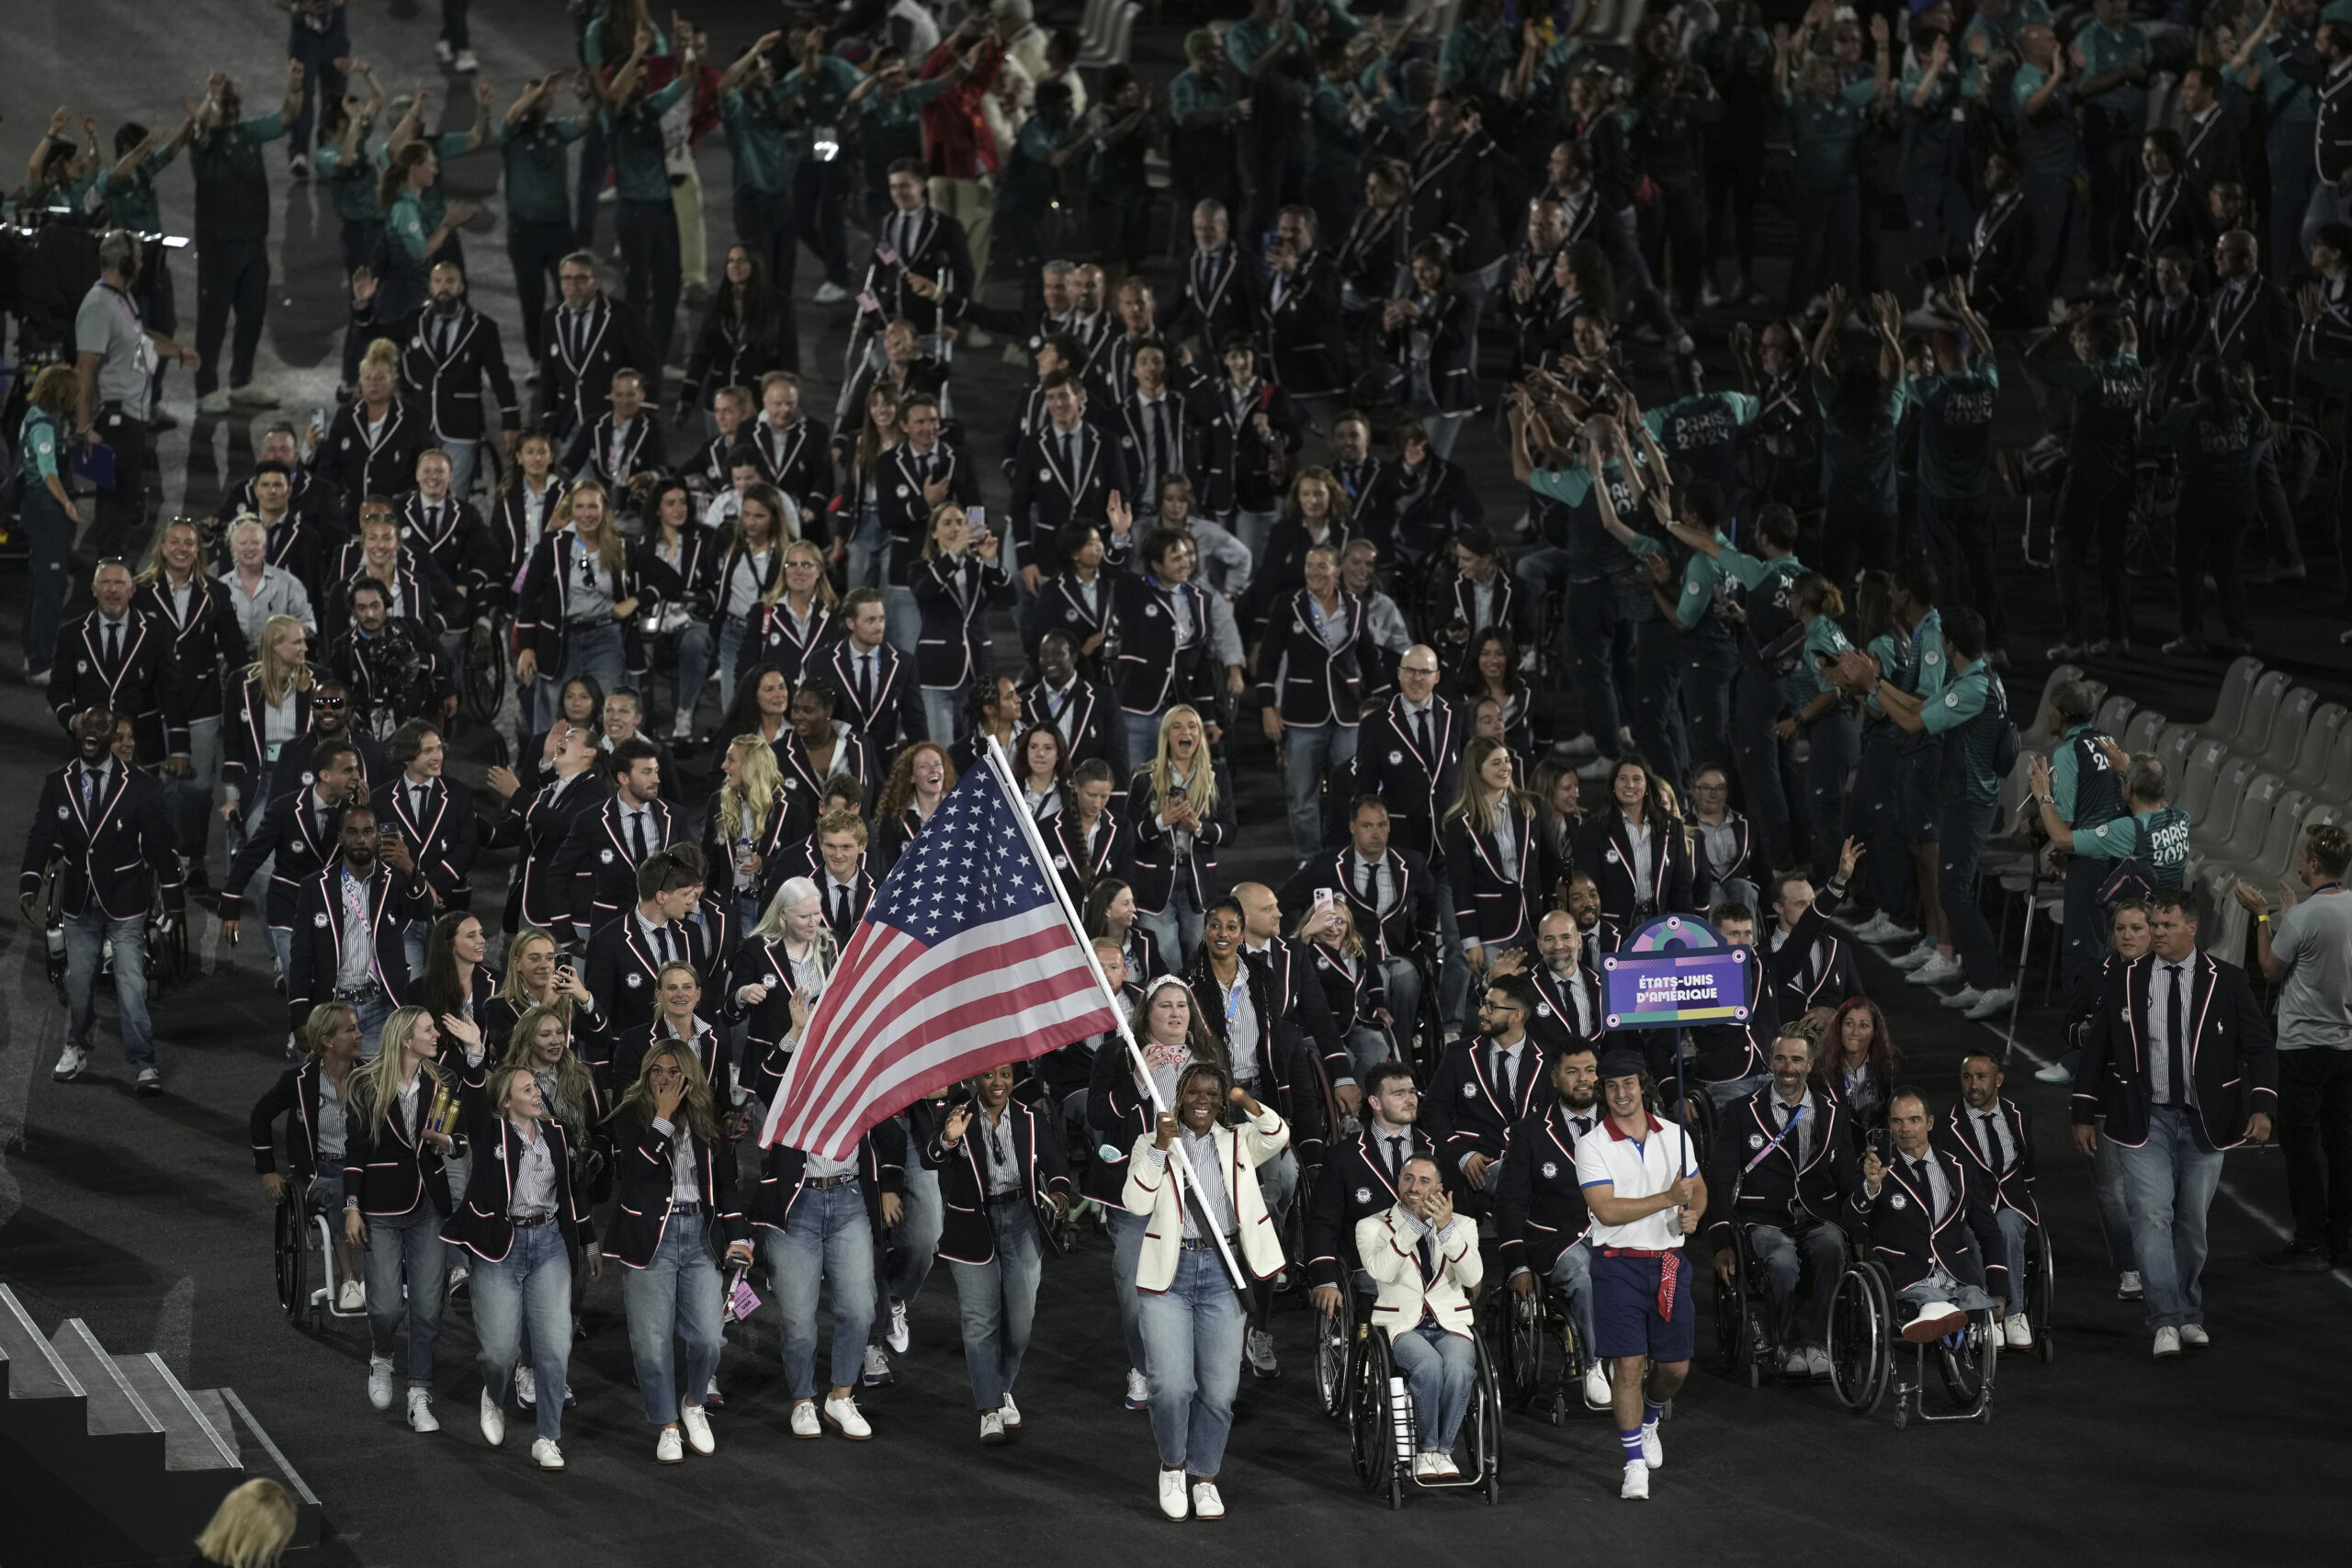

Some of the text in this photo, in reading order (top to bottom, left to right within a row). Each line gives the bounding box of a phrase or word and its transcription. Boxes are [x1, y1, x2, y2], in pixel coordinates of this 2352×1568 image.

[1675, 410, 1726, 434] PARIS
[1676, 426, 1729, 450] 2024
[2151, 820, 2188, 850] PARIS
[2153, 840, 2189, 866] 2024
[1638, 974, 1714, 989] ÉTATS-UNIS
[1636, 986, 1718, 1003] D'AMÉRIQUE
[741, 1300, 752, 1310] USA
